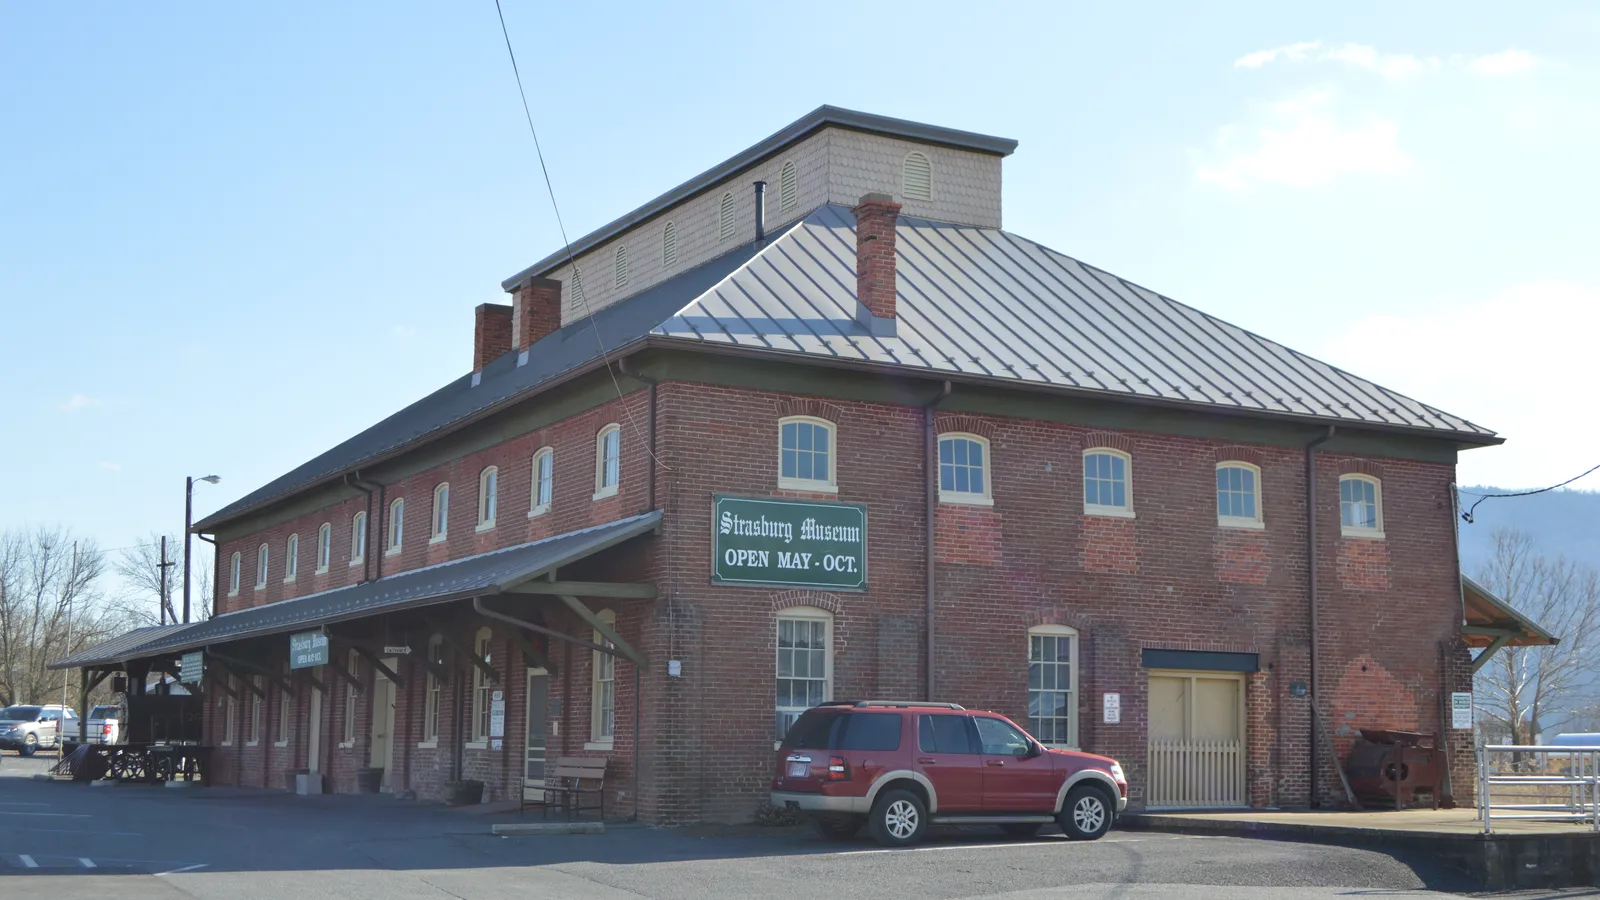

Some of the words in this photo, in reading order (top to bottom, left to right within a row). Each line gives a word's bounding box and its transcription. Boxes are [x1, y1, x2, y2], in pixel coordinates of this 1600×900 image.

[720, 511, 793, 544] Strasburg
[800, 517, 860, 542] Museum
[725, 548, 769, 567] OPEN
[777, 551, 812, 569] MAY
[823, 554, 857, 573] OCT.
